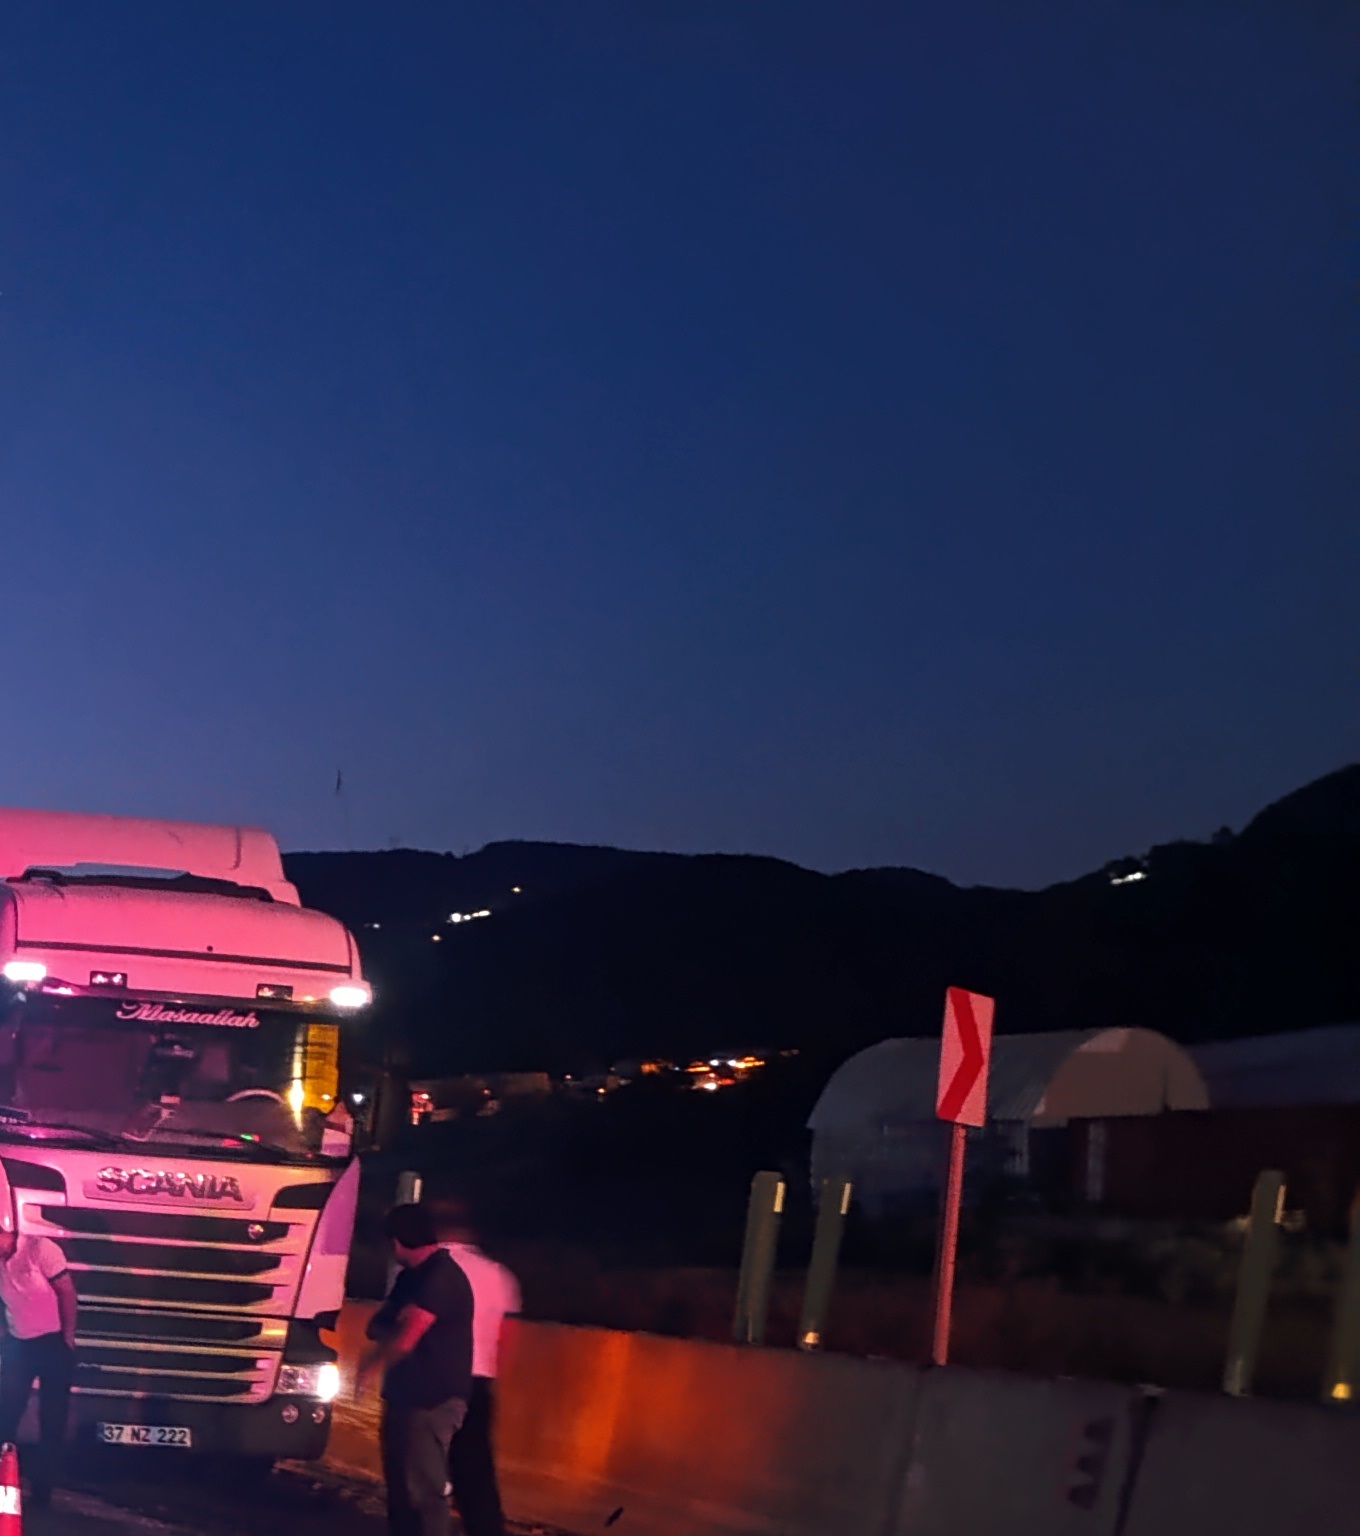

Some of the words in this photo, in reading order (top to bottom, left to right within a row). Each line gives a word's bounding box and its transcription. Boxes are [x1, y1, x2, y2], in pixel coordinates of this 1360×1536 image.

[96, 1166, 244, 1202] SCANIA
[104, 1426, 124, 1441] 37
[131, 1427, 151, 1442] NZ
[158, 1428, 187, 1444] 222
